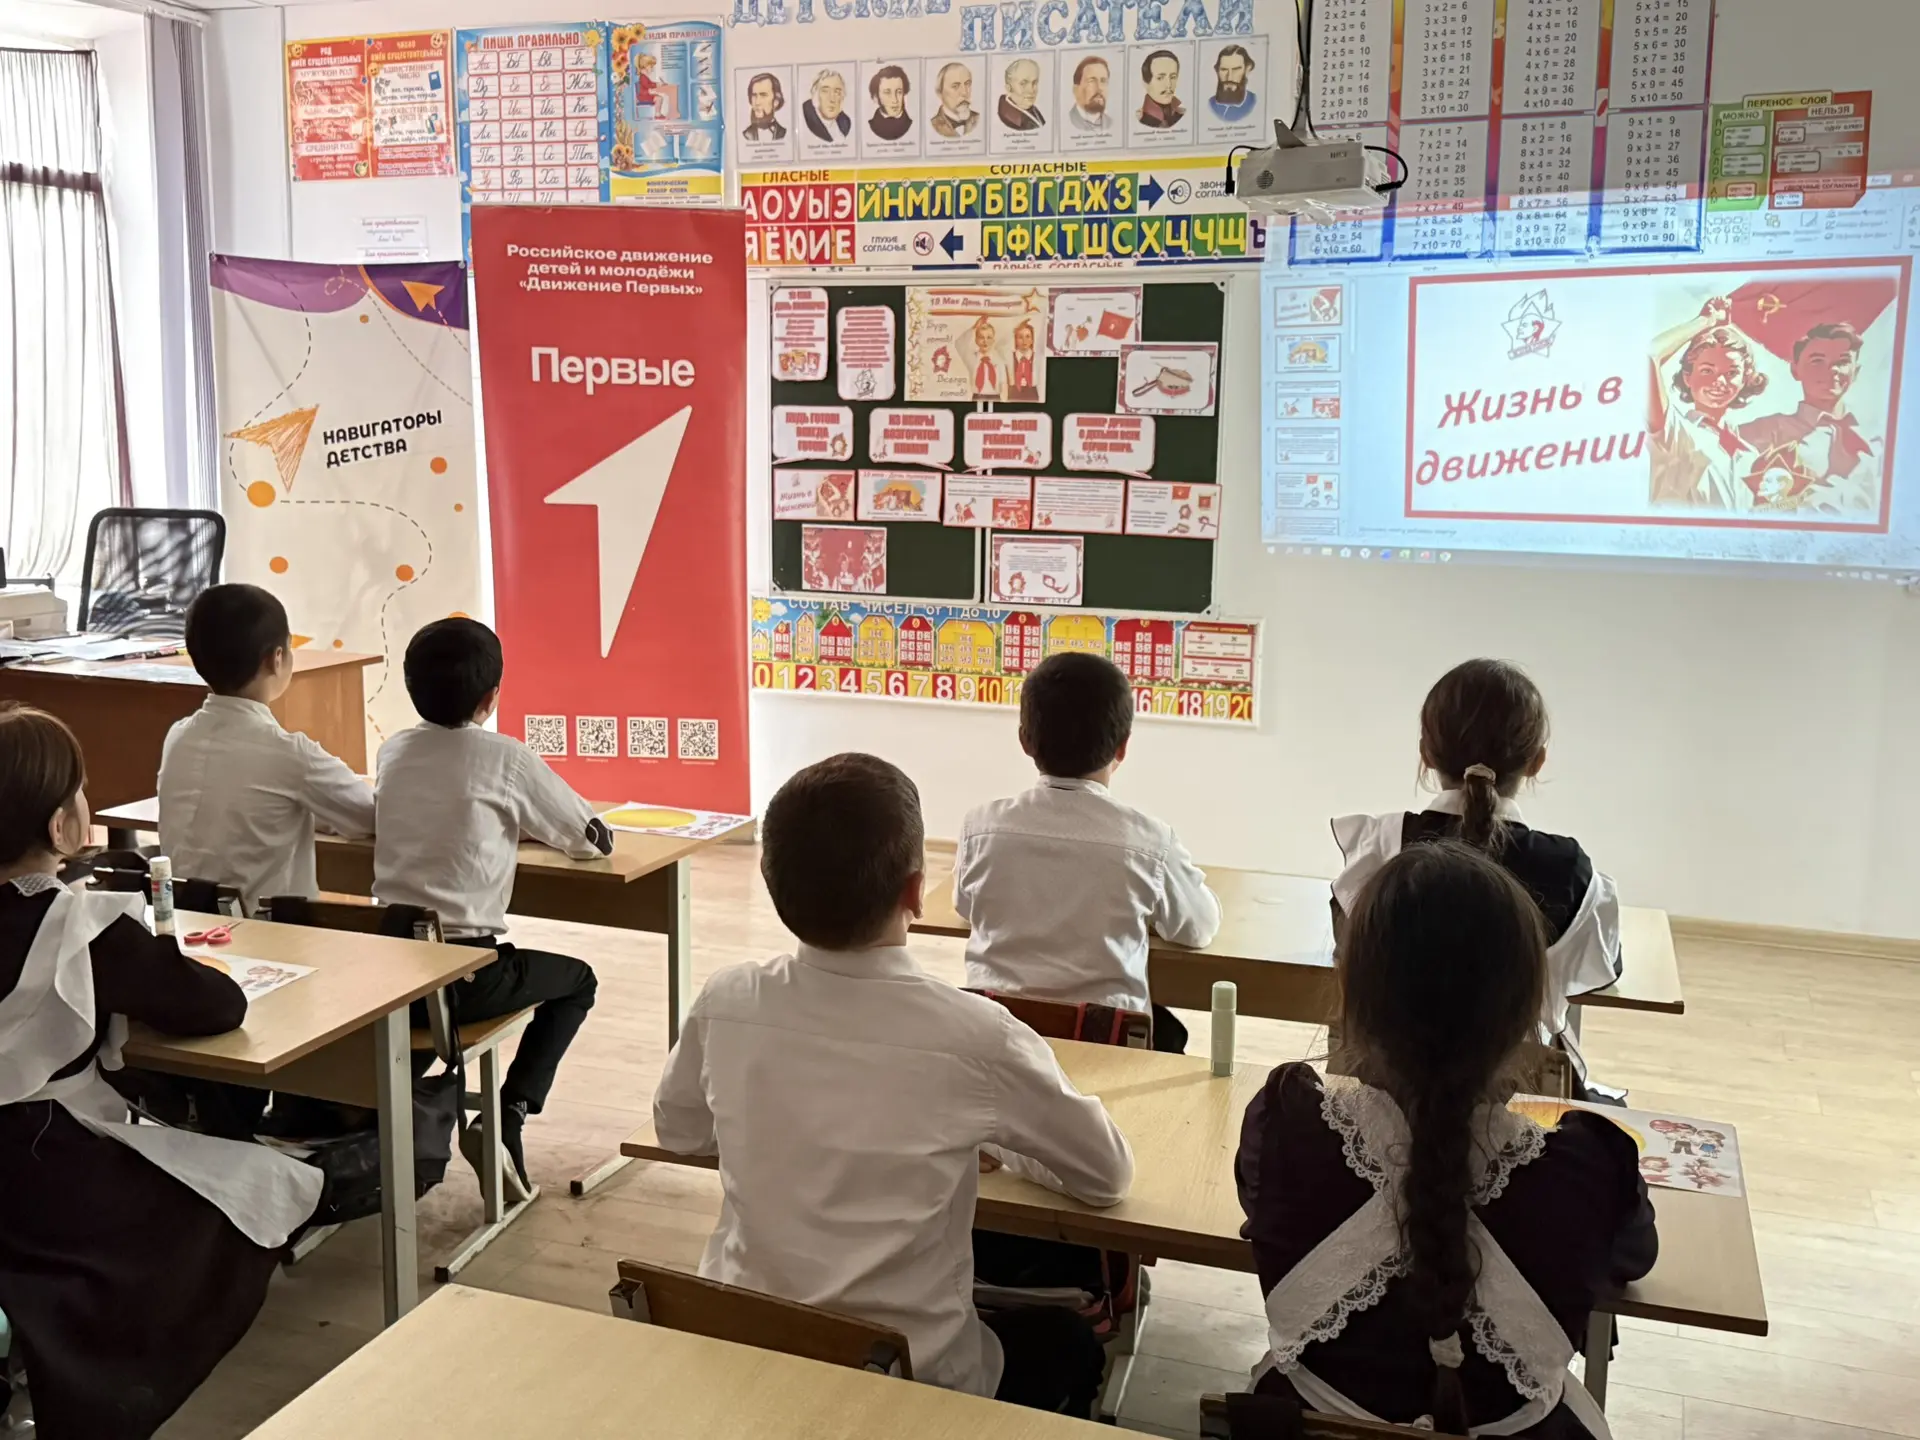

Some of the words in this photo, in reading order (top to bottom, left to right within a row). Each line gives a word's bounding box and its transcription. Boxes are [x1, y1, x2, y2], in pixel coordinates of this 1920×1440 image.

[484, 36, 514, 49] ПИШИ
[518, 32, 579, 47] ПРАВИЛЬНО
[1747, 98, 1794, 108] ПЕРЕНОС
[1800, 96, 1828, 105] СЛОВ
[1722, 111, 1760, 120] МОЖНО
[1810, 106, 1850, 116] НЕЛЬЗЯ
[762, 170, 830, 182] ГЛАСНЫЕ
[990, 161, 1087, 175] СОГЛАСНЫЕ
[863, 244, 907, 252] СОГЛАСНЫЕ
[871, 236, 898, 245] ГЛУХИЕ
[507, 244, 618, 261] Российское
[620, 251, 714, 264] движение
[528, 262, 581, 276] детей
[584, 264, 596, 276] и
[600, 265, 694, 280] молодёжи
[520, 277, 622, 292] «Движение
[626, 280, 703, 296] Первых»
[531, 346, 696, 395] Первые
[1437, 384, 1582, 429] Жизнь
[1597, 376, 1624, 405] в
[324, 410, 442, 445] НАВИГАТОРЫ
[326, 438, 408, 469] ДЕТСТВА
[1415, 430, 1646, 486] движении
[789, 599, 850, 611] СОСТАВ
[862, 601, 914, 614] ЧИСЕЛ
[754, 664, 770, 689] 0
[778, 668, 790, 690] 1
[798, 668, 814, 691] 2
[820, 669, 836, 692] 3
[840, 670, 859, 694] 4
[866, 672, 882, 696] 5
[888, 673, 905, 698] 6
[912, 675, 928, 698] 7
[936, 676, 952, 700] 8
[959, 677, 976, 702] 9
[979, 680, 1000, 704] 10
[1154, 691, 1178, 716] 17
[1179, 692, 1202, 718] 18
[1205, 694, 1228, 719] 19
